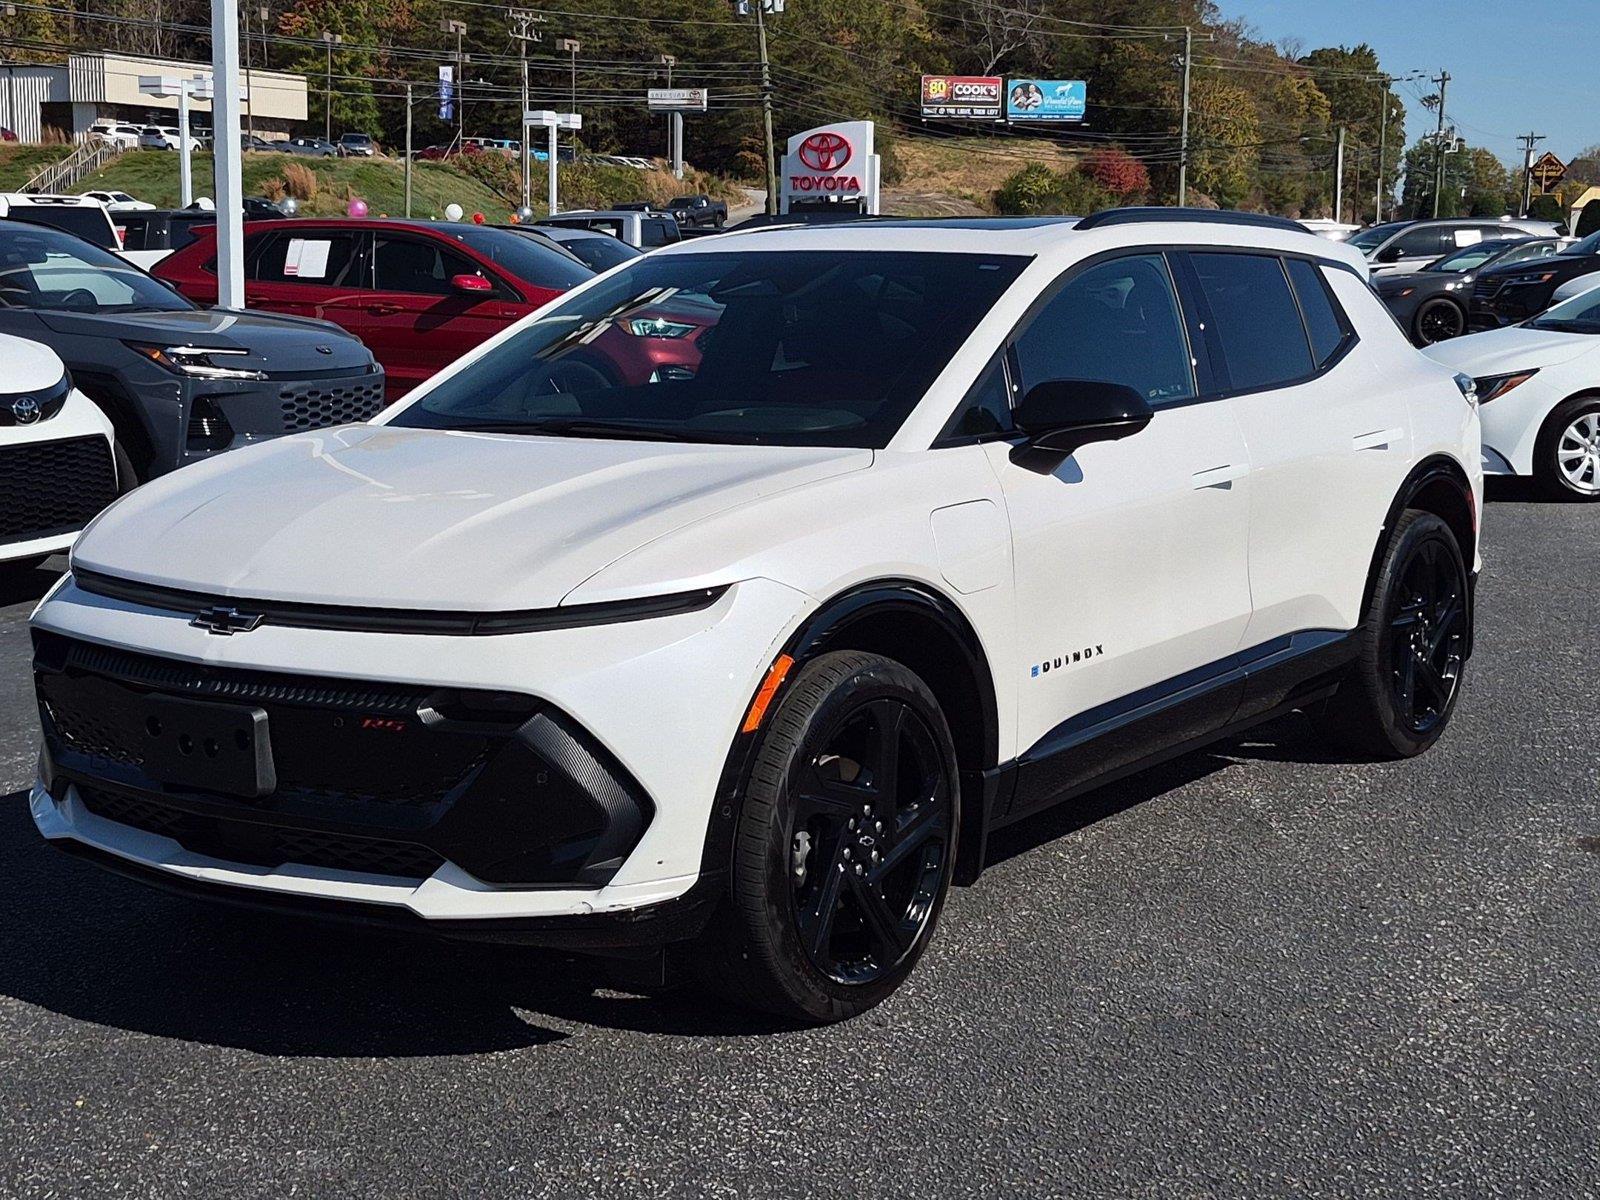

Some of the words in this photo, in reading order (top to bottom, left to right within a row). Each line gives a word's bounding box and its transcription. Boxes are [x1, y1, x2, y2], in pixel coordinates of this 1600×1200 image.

[929, 81, 946, 94] 80
[955, 85, 997, 95] COOK'S
[790, 176, 861, 191] TOYOTA
[1031, 644, 1103, 677] EQUINOX
